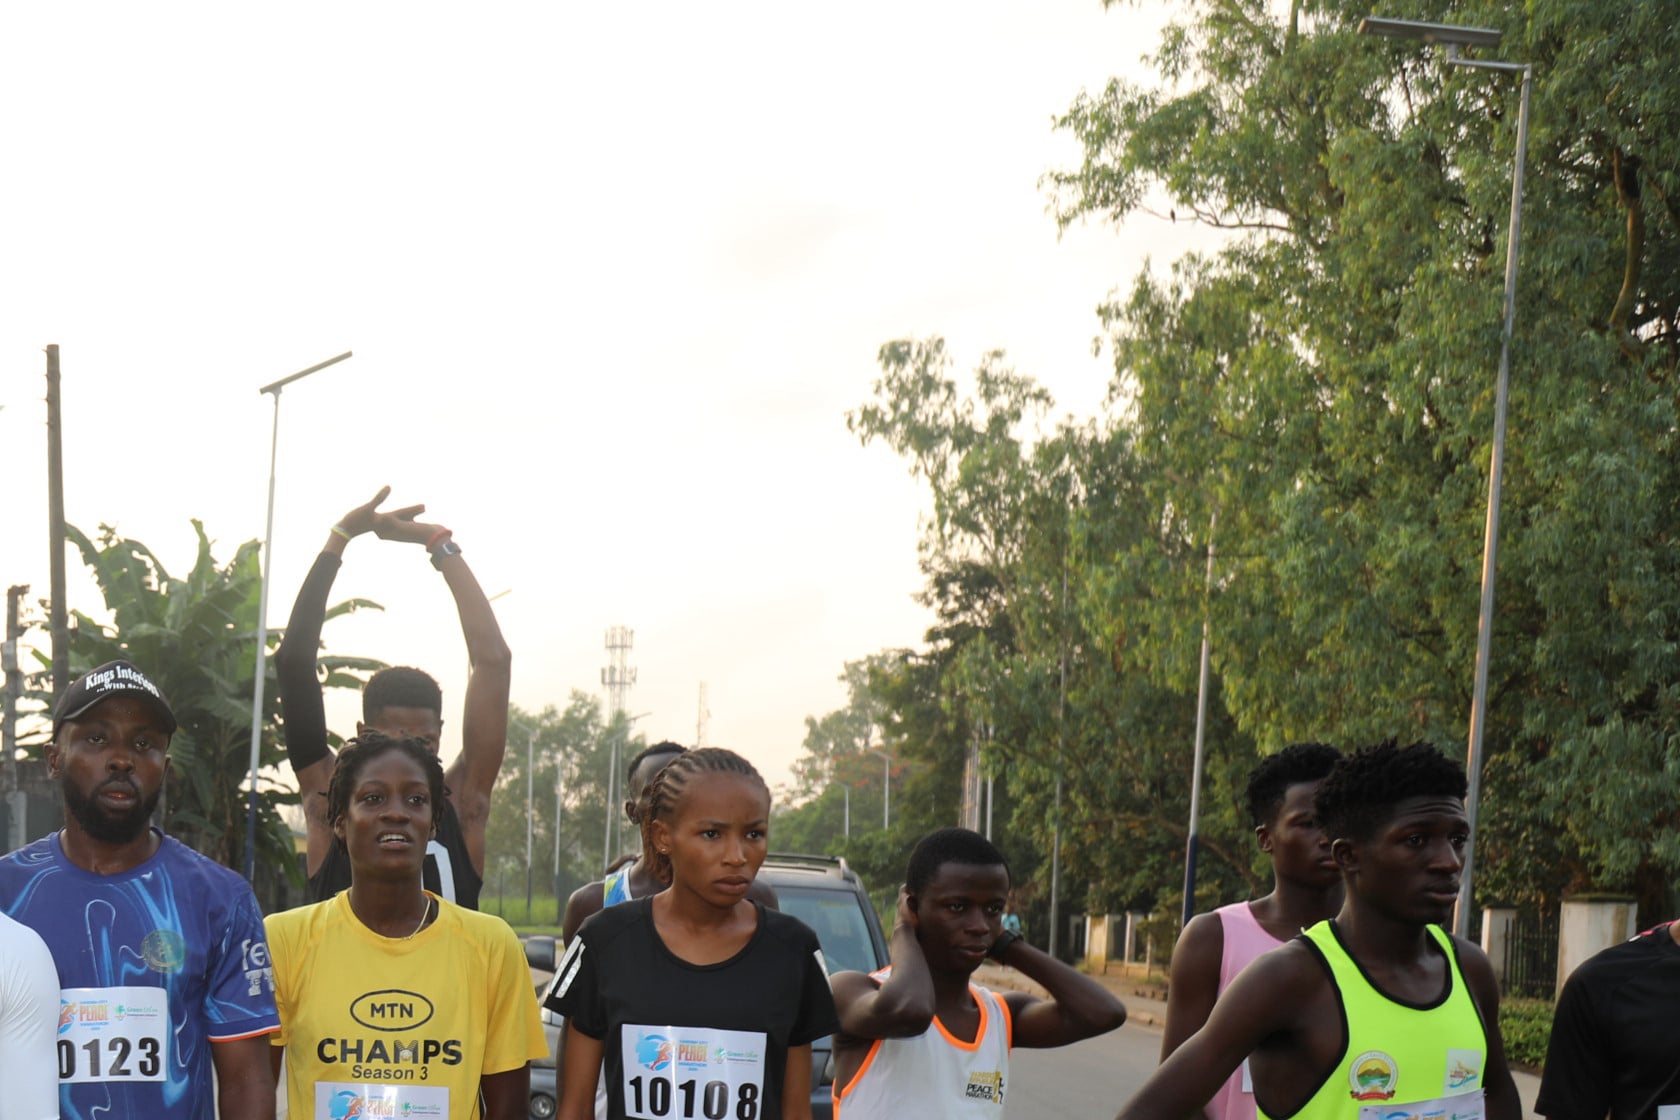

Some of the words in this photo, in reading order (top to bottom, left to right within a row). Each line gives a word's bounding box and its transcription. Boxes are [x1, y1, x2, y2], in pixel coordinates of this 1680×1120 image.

[85, 669, 115, 690] Kings
[370, 1003, 413, 1018] MTN
[317, 1037, 463, 1066] CHAMPS
[352, 1064, 414, 1079] Season
[420, 1065, 428, 1081] 3
[967, 1083, 994, 1095] PEACE
